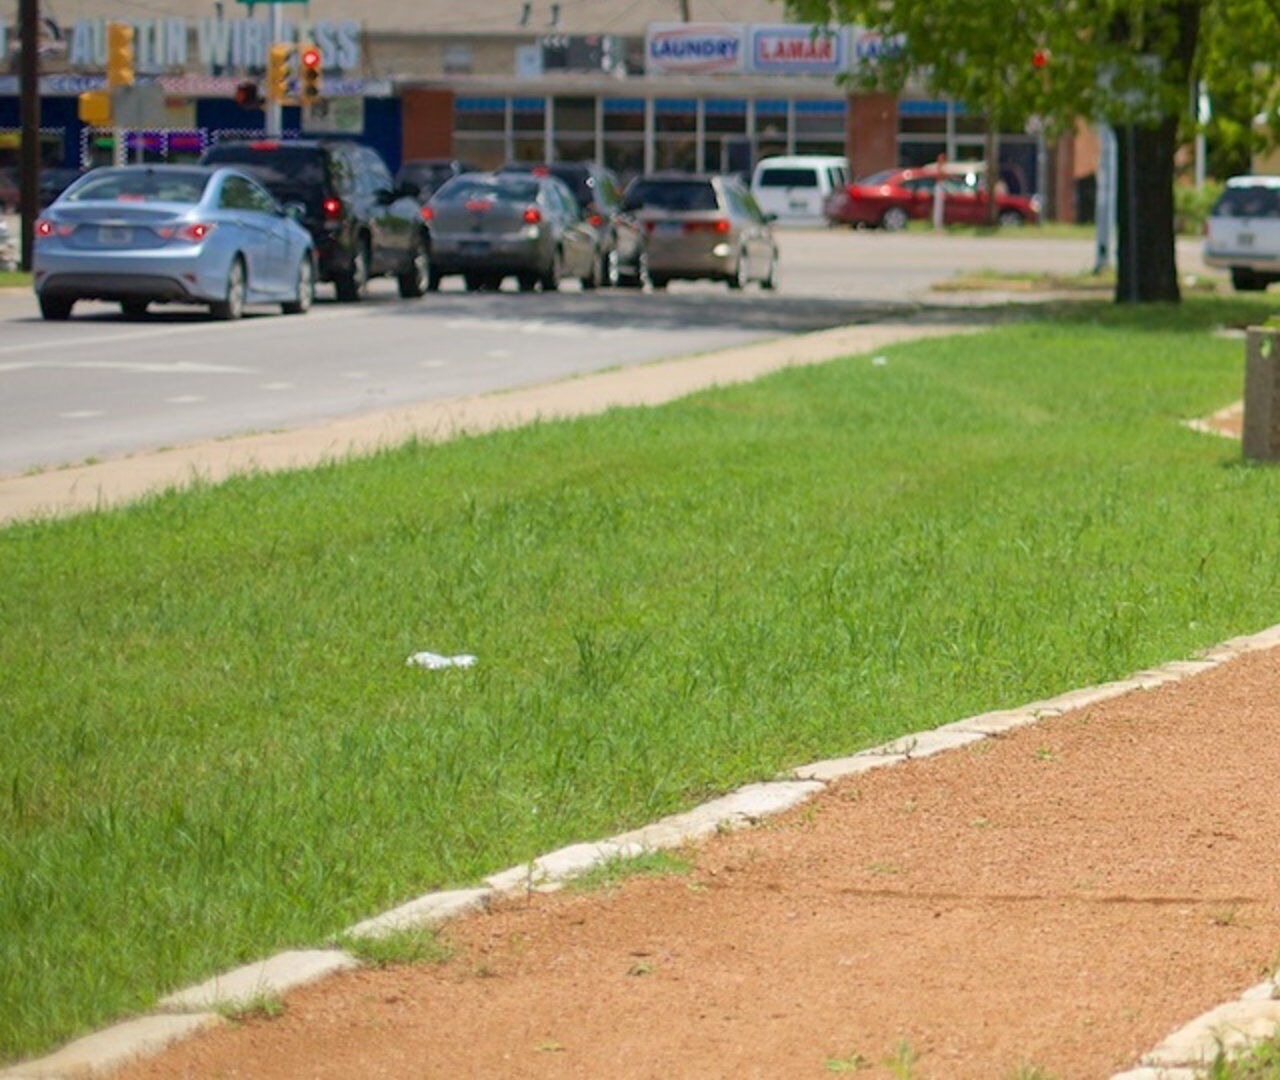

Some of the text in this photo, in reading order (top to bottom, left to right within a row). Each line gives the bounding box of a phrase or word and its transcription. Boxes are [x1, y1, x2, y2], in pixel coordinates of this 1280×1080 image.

[69, 17, 360, 69] AUTIN WIRLESS
[650, 36, 739, 58] LAUNDRY
[759, 37, 833, 61] LAMAR
